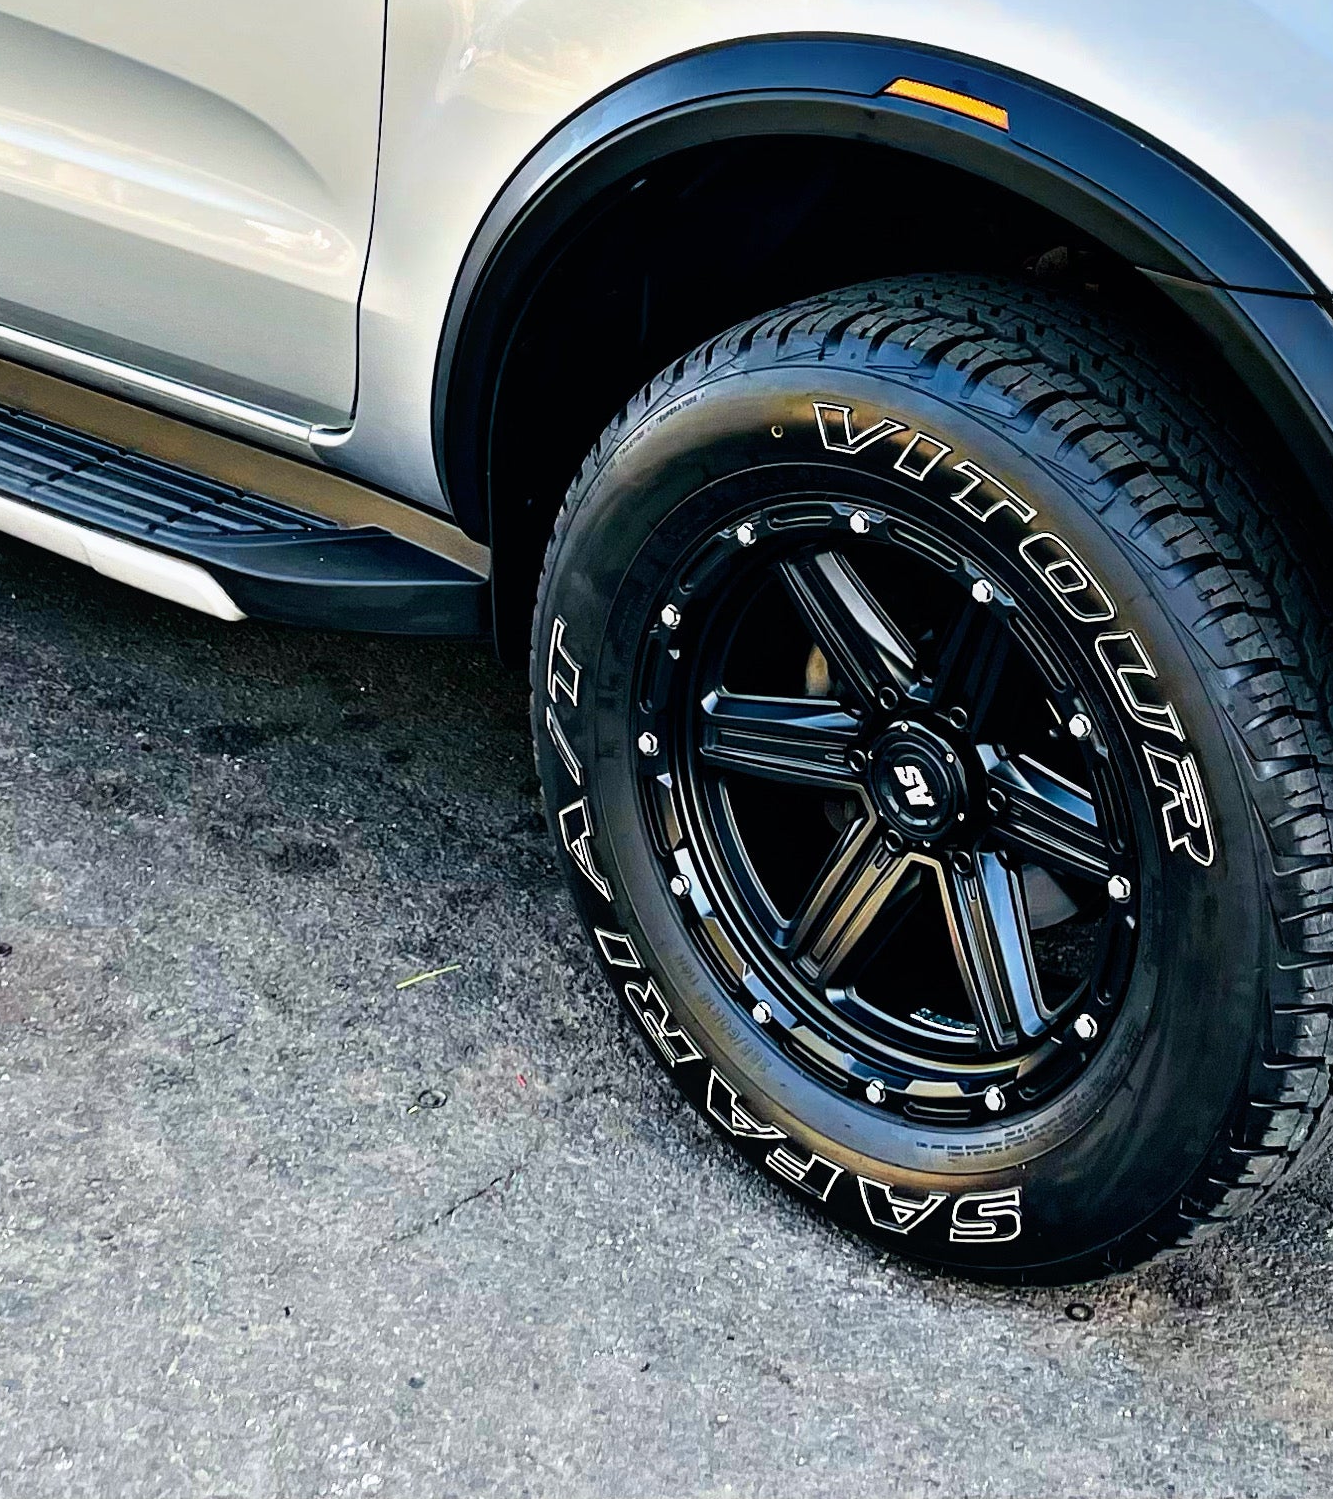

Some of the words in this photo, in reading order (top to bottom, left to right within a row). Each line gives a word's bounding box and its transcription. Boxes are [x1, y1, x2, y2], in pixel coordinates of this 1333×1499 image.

[543, 616, 614, 901] A/T
[811, 402, 1217, 868] VITOUR
[595, 925, 1024, 1245] SAFARI
